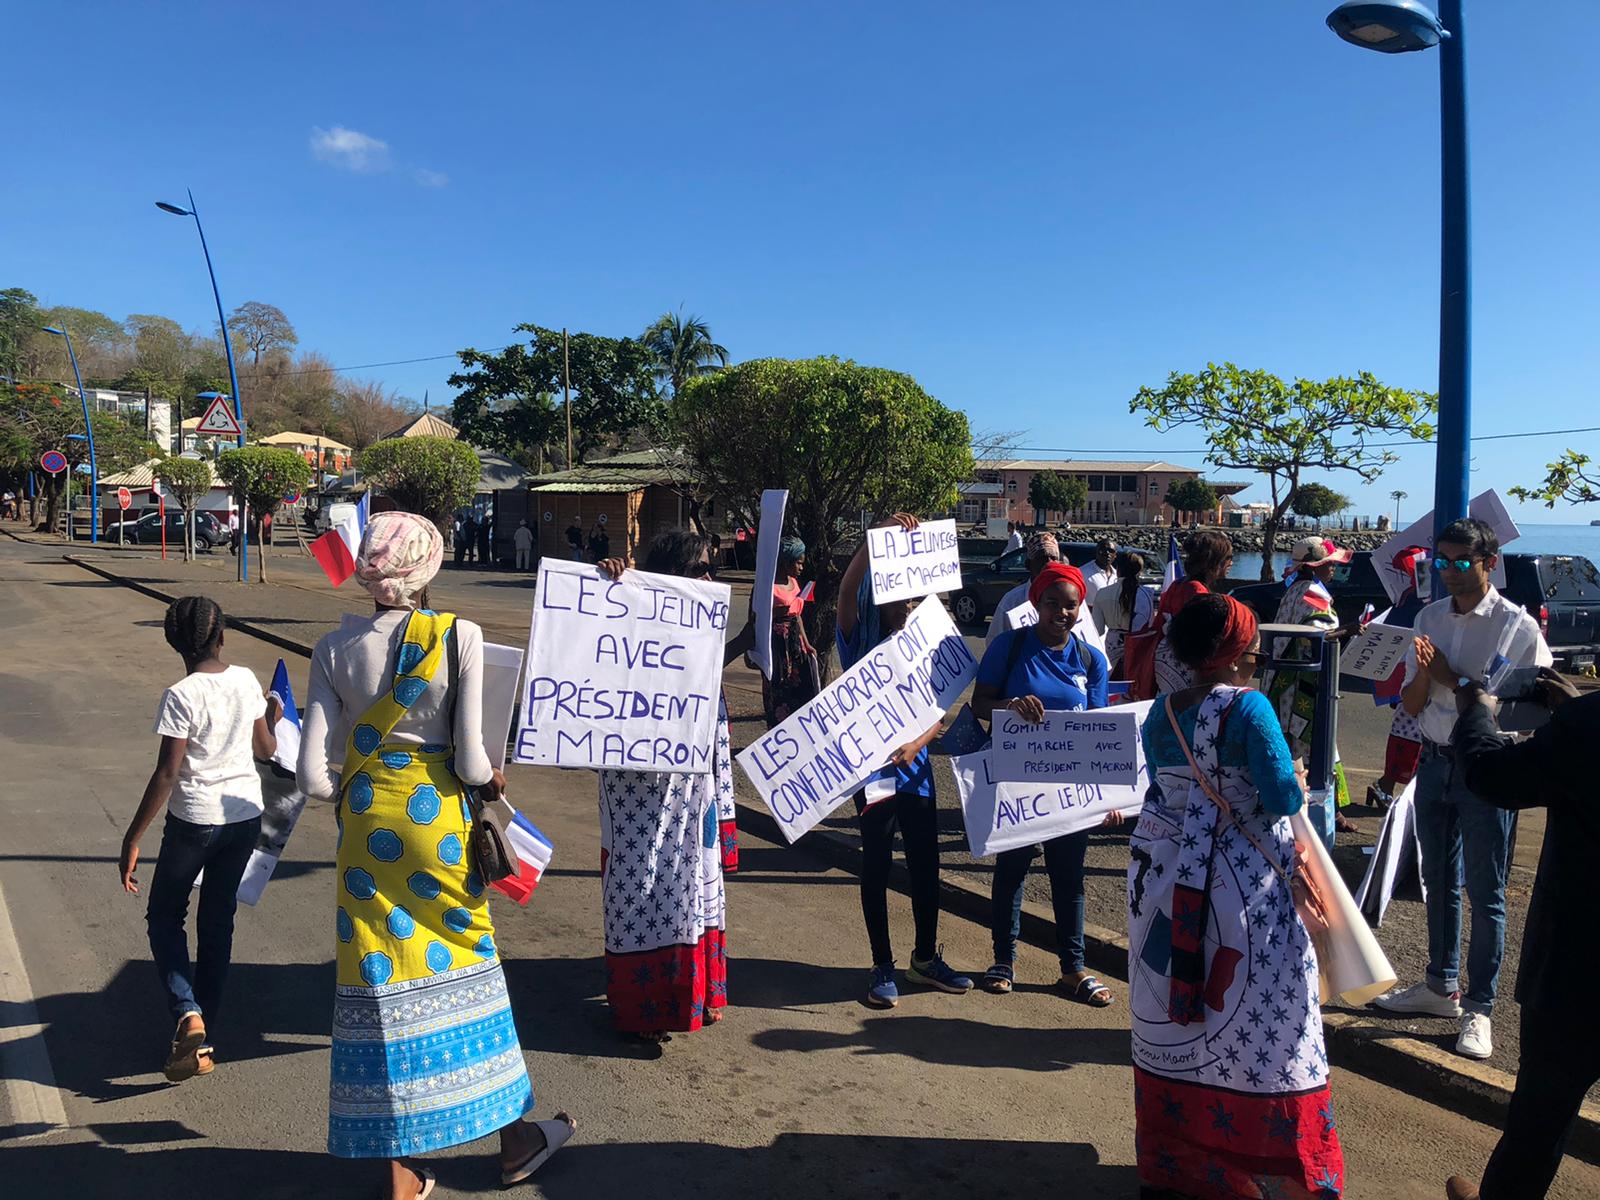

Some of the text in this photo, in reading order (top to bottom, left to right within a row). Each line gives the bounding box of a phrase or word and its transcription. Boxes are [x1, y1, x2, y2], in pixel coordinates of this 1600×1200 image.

[871, 531, 897, 559] LA
[873, 561, 959, 595] AVEC MACRON
[543, 570, 729, 630] LES JEUNES
[596, 634, 685, 670] AVEC
[1353, 632, 1384, 670] MACRON
[528, 677, 709, 726] PRÉSIDENT
[751, 616, 928, 781] LES MAHORAIS ONT
[770, 626, 974, 824] CONFIANCE EN MACRON
[1003, 717, 1117, 735] COMITÉ FEMMES
[556, 730, 711, 767] MACRON
[1003, 741, 1122, 754] EN MARCHE AVEC
[1024, 760, 1133, 774] PRÉSIDENT MACRON
[996, 793, 1050, 829] AVEC
[1058, 786, 1075, 810] LE
[372, 983, 405, 997] HASIRA
[409, 980, 418, 988] NI
[456, 968, 468, 977] WA
